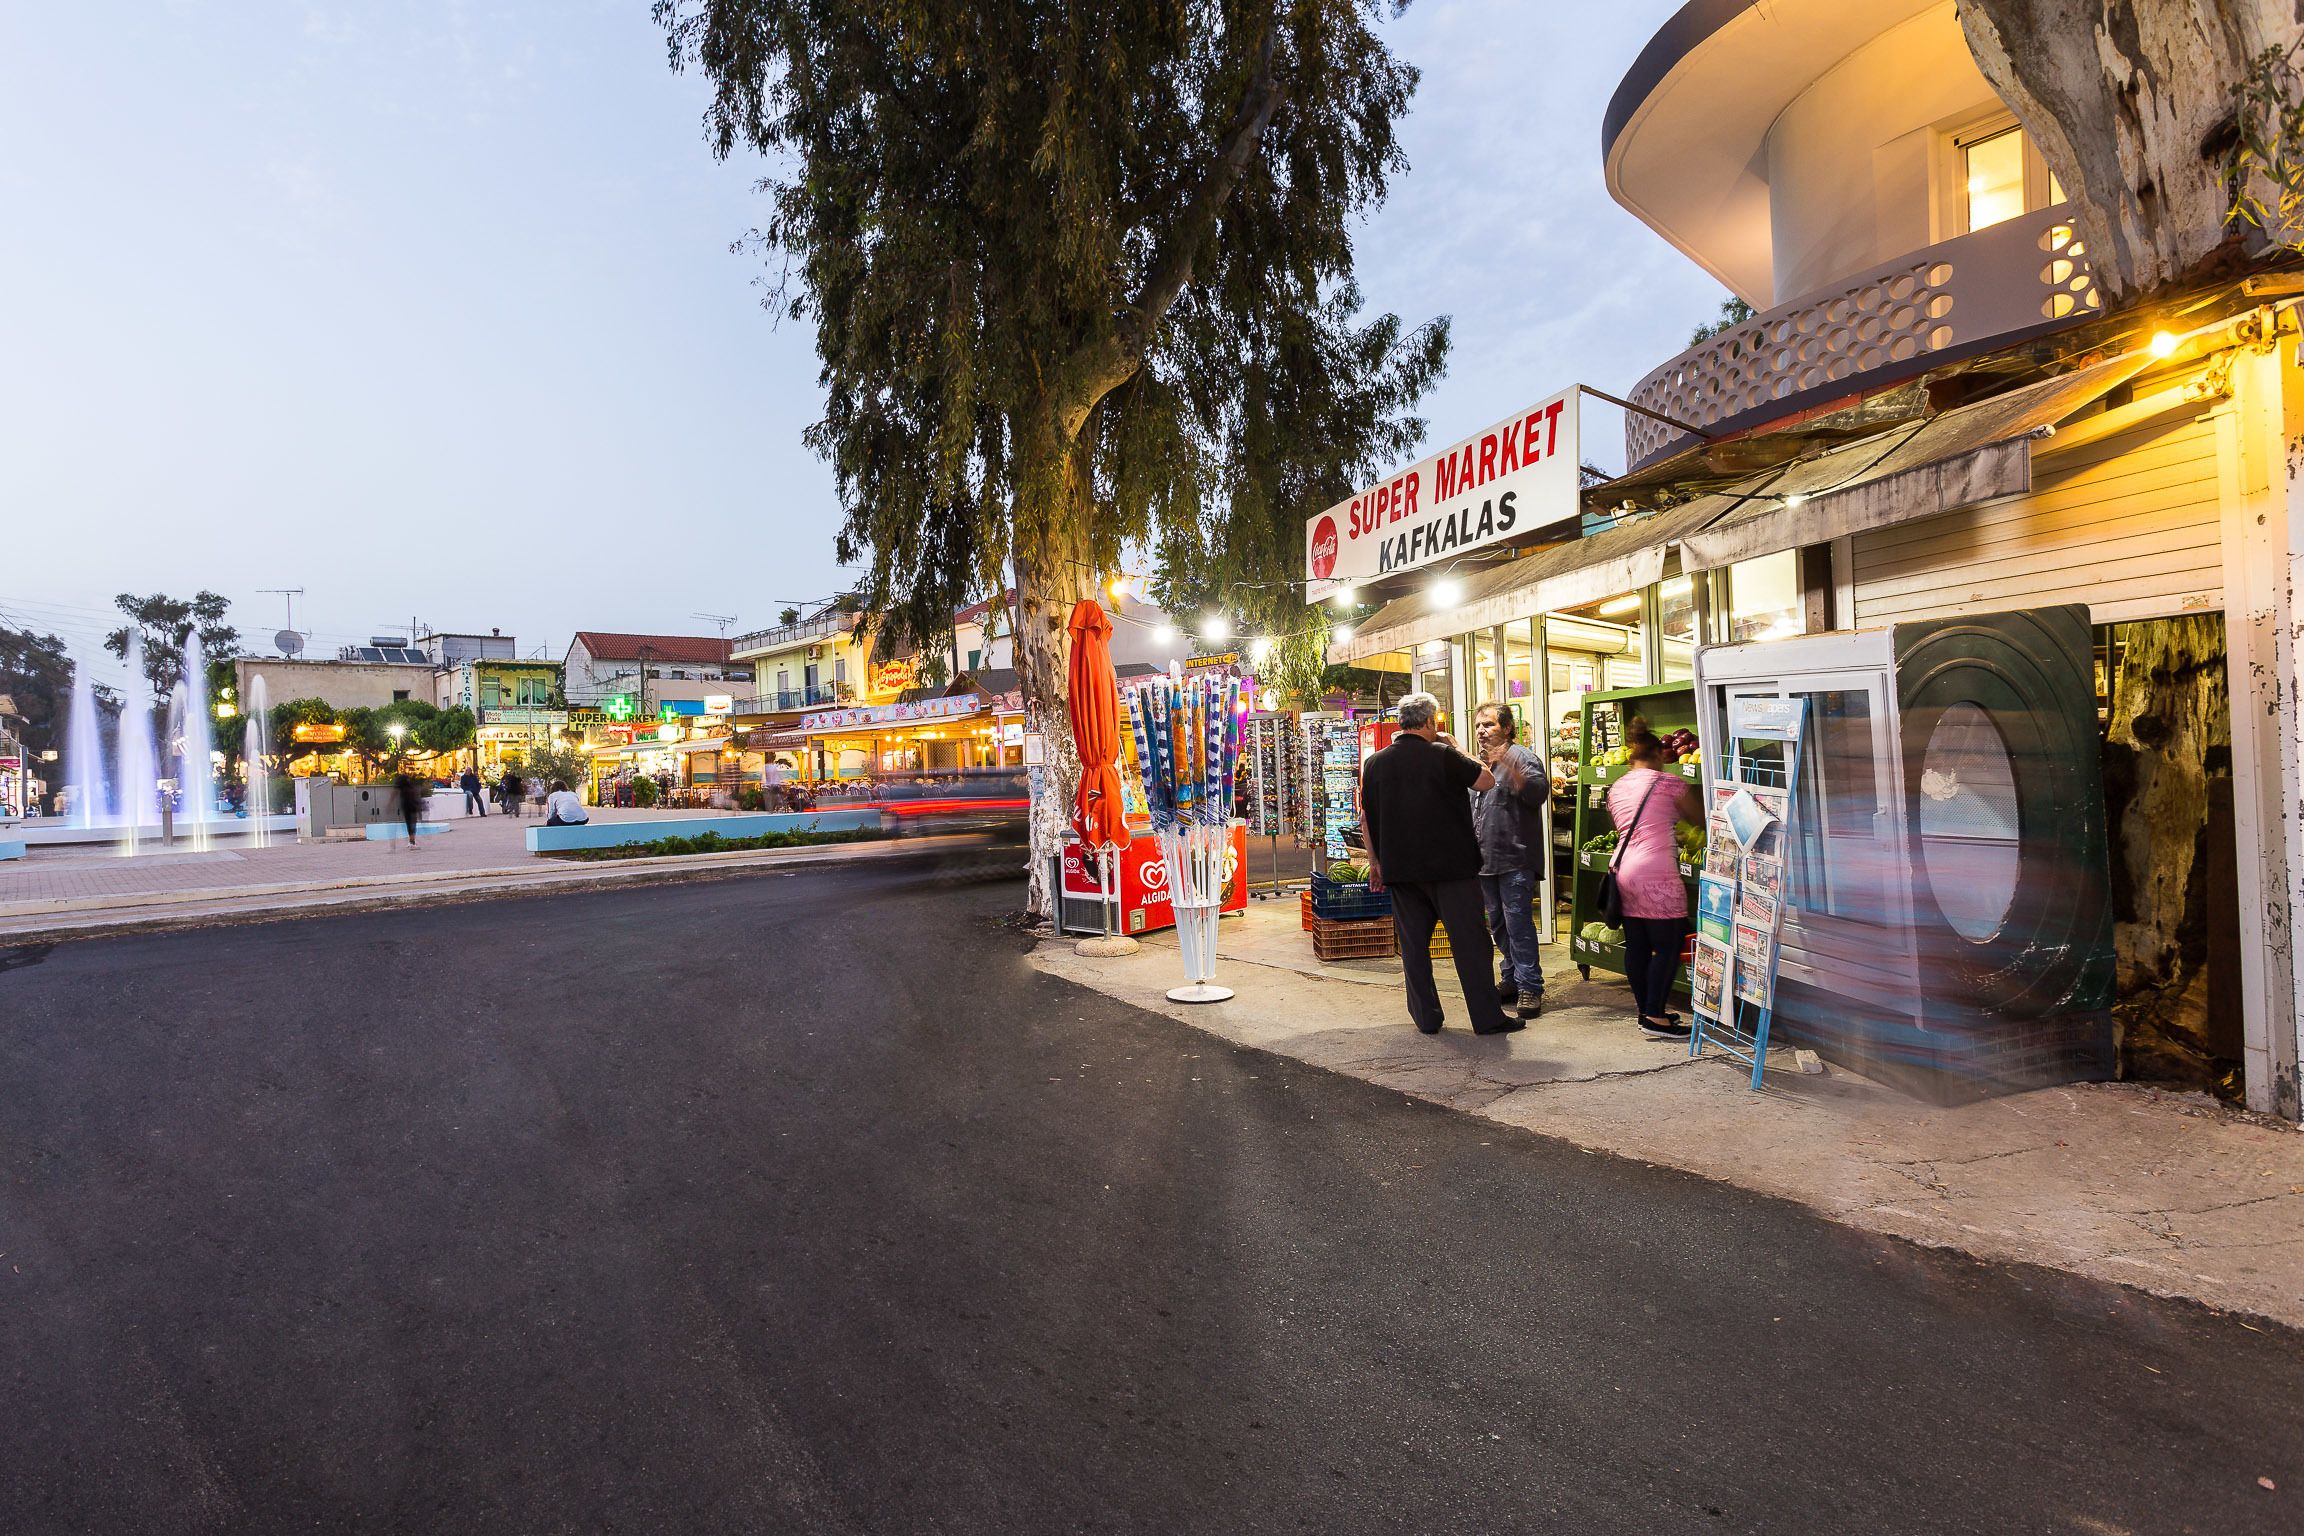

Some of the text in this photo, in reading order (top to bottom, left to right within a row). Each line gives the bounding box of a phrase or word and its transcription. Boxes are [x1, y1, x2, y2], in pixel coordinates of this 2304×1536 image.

[1349, 399, 1565, 540] SUPER MARKET
[1379, 491, 1518, 574] KAFKALAS
[1185, 655, 1223, 668] INTERNET
[1140, 889, 1173, 906] ALGIDA
